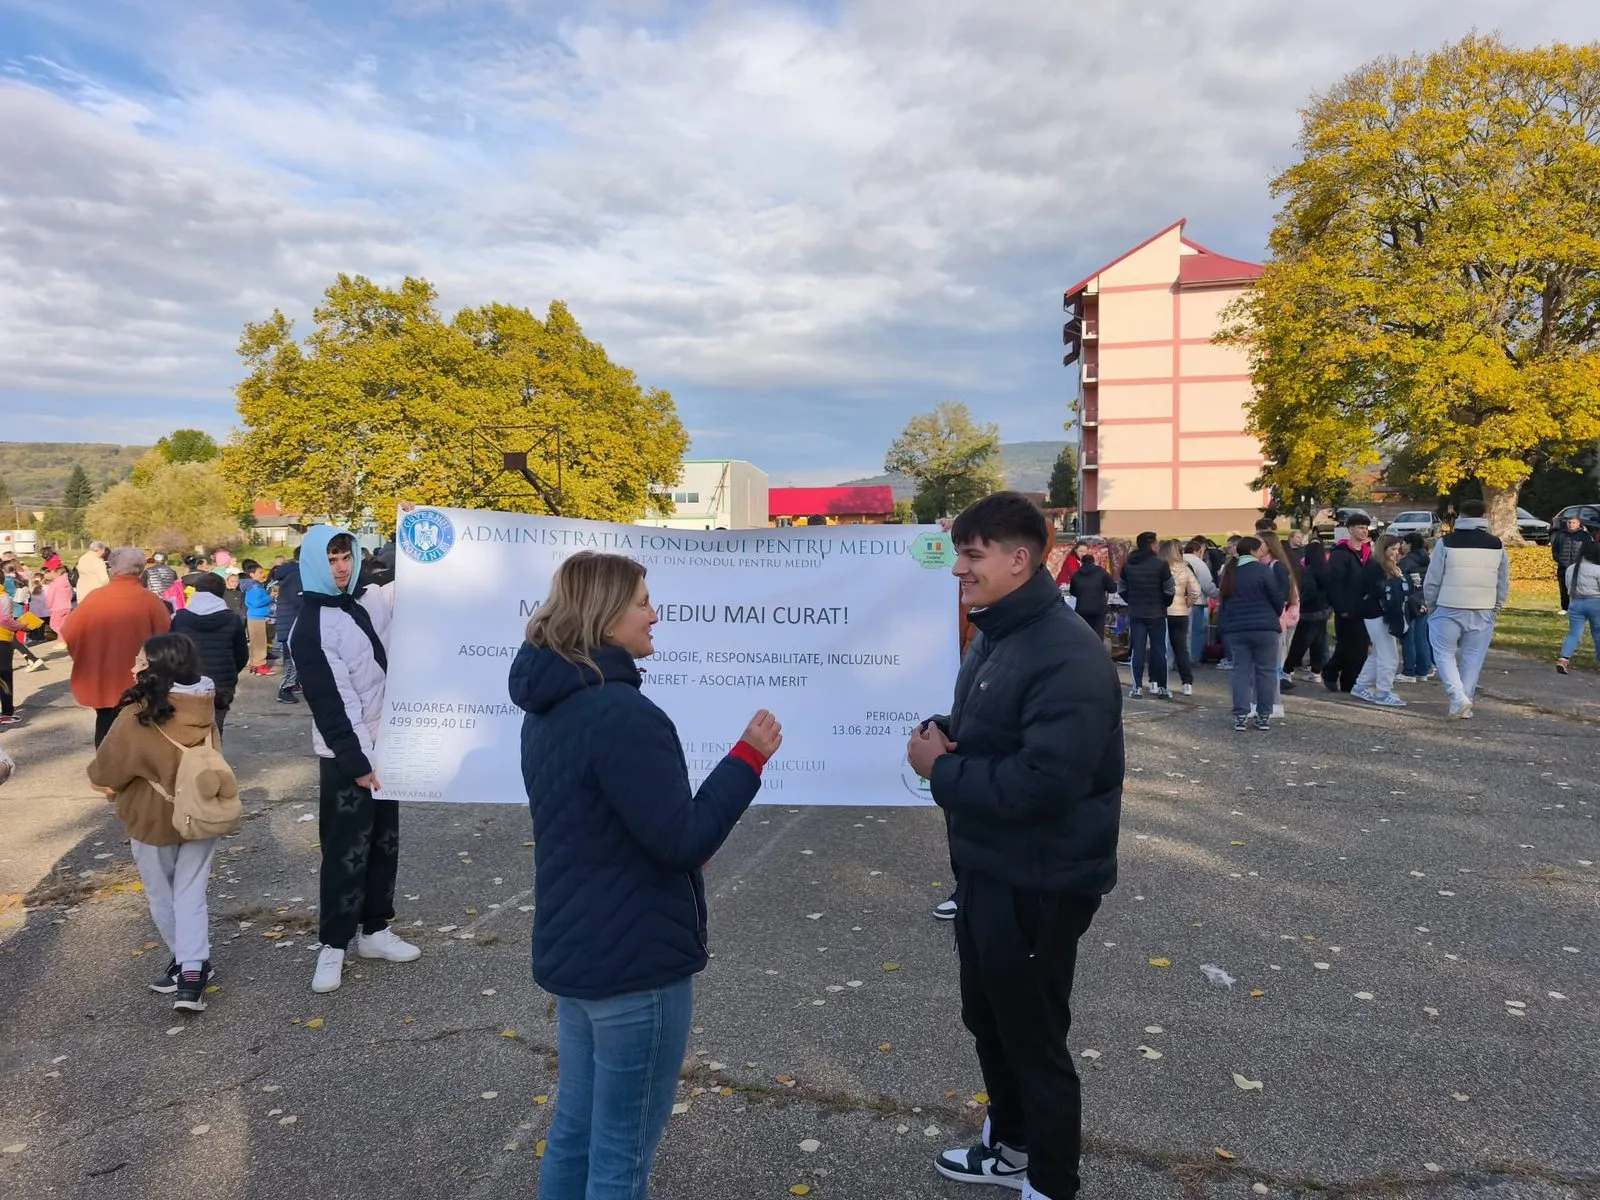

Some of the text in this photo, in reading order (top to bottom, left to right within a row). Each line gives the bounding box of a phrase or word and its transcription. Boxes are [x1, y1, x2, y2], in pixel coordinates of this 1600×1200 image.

[403, 511, 451, 531] GUVERNUL
[640, 534, 746, 553] FONDULUI
[755, 538, 832, 554] PENTRU
[839, 539, 906, 556] MEDIU
[664, 555, 686, 565] DIN
[689, 556, 735, 567] FONDUL
[739, 558, 781, 568] PENTRU
[785, 559, 822, 568] MEDIU
[724, 605, 765, 624] MAI
[772, 606, 849, 625] CURAT!
[706, 651, 824, 666] RESPONSABILITATE,
[827, 653, 900, 666] INCLUZIUNE
[769, 675, 808, 687] MERIT
[391, 701, 454, 714] VALOAREA
[866, 711, 921, 721] PERIOADA
[389, 716, 476, 730] 499.999,40 LEI
[832, 725, 892, 736] 13.06.2024
[701, 742, 736, 753] PENT
[767, 760, 825, 771] BLICULUI
